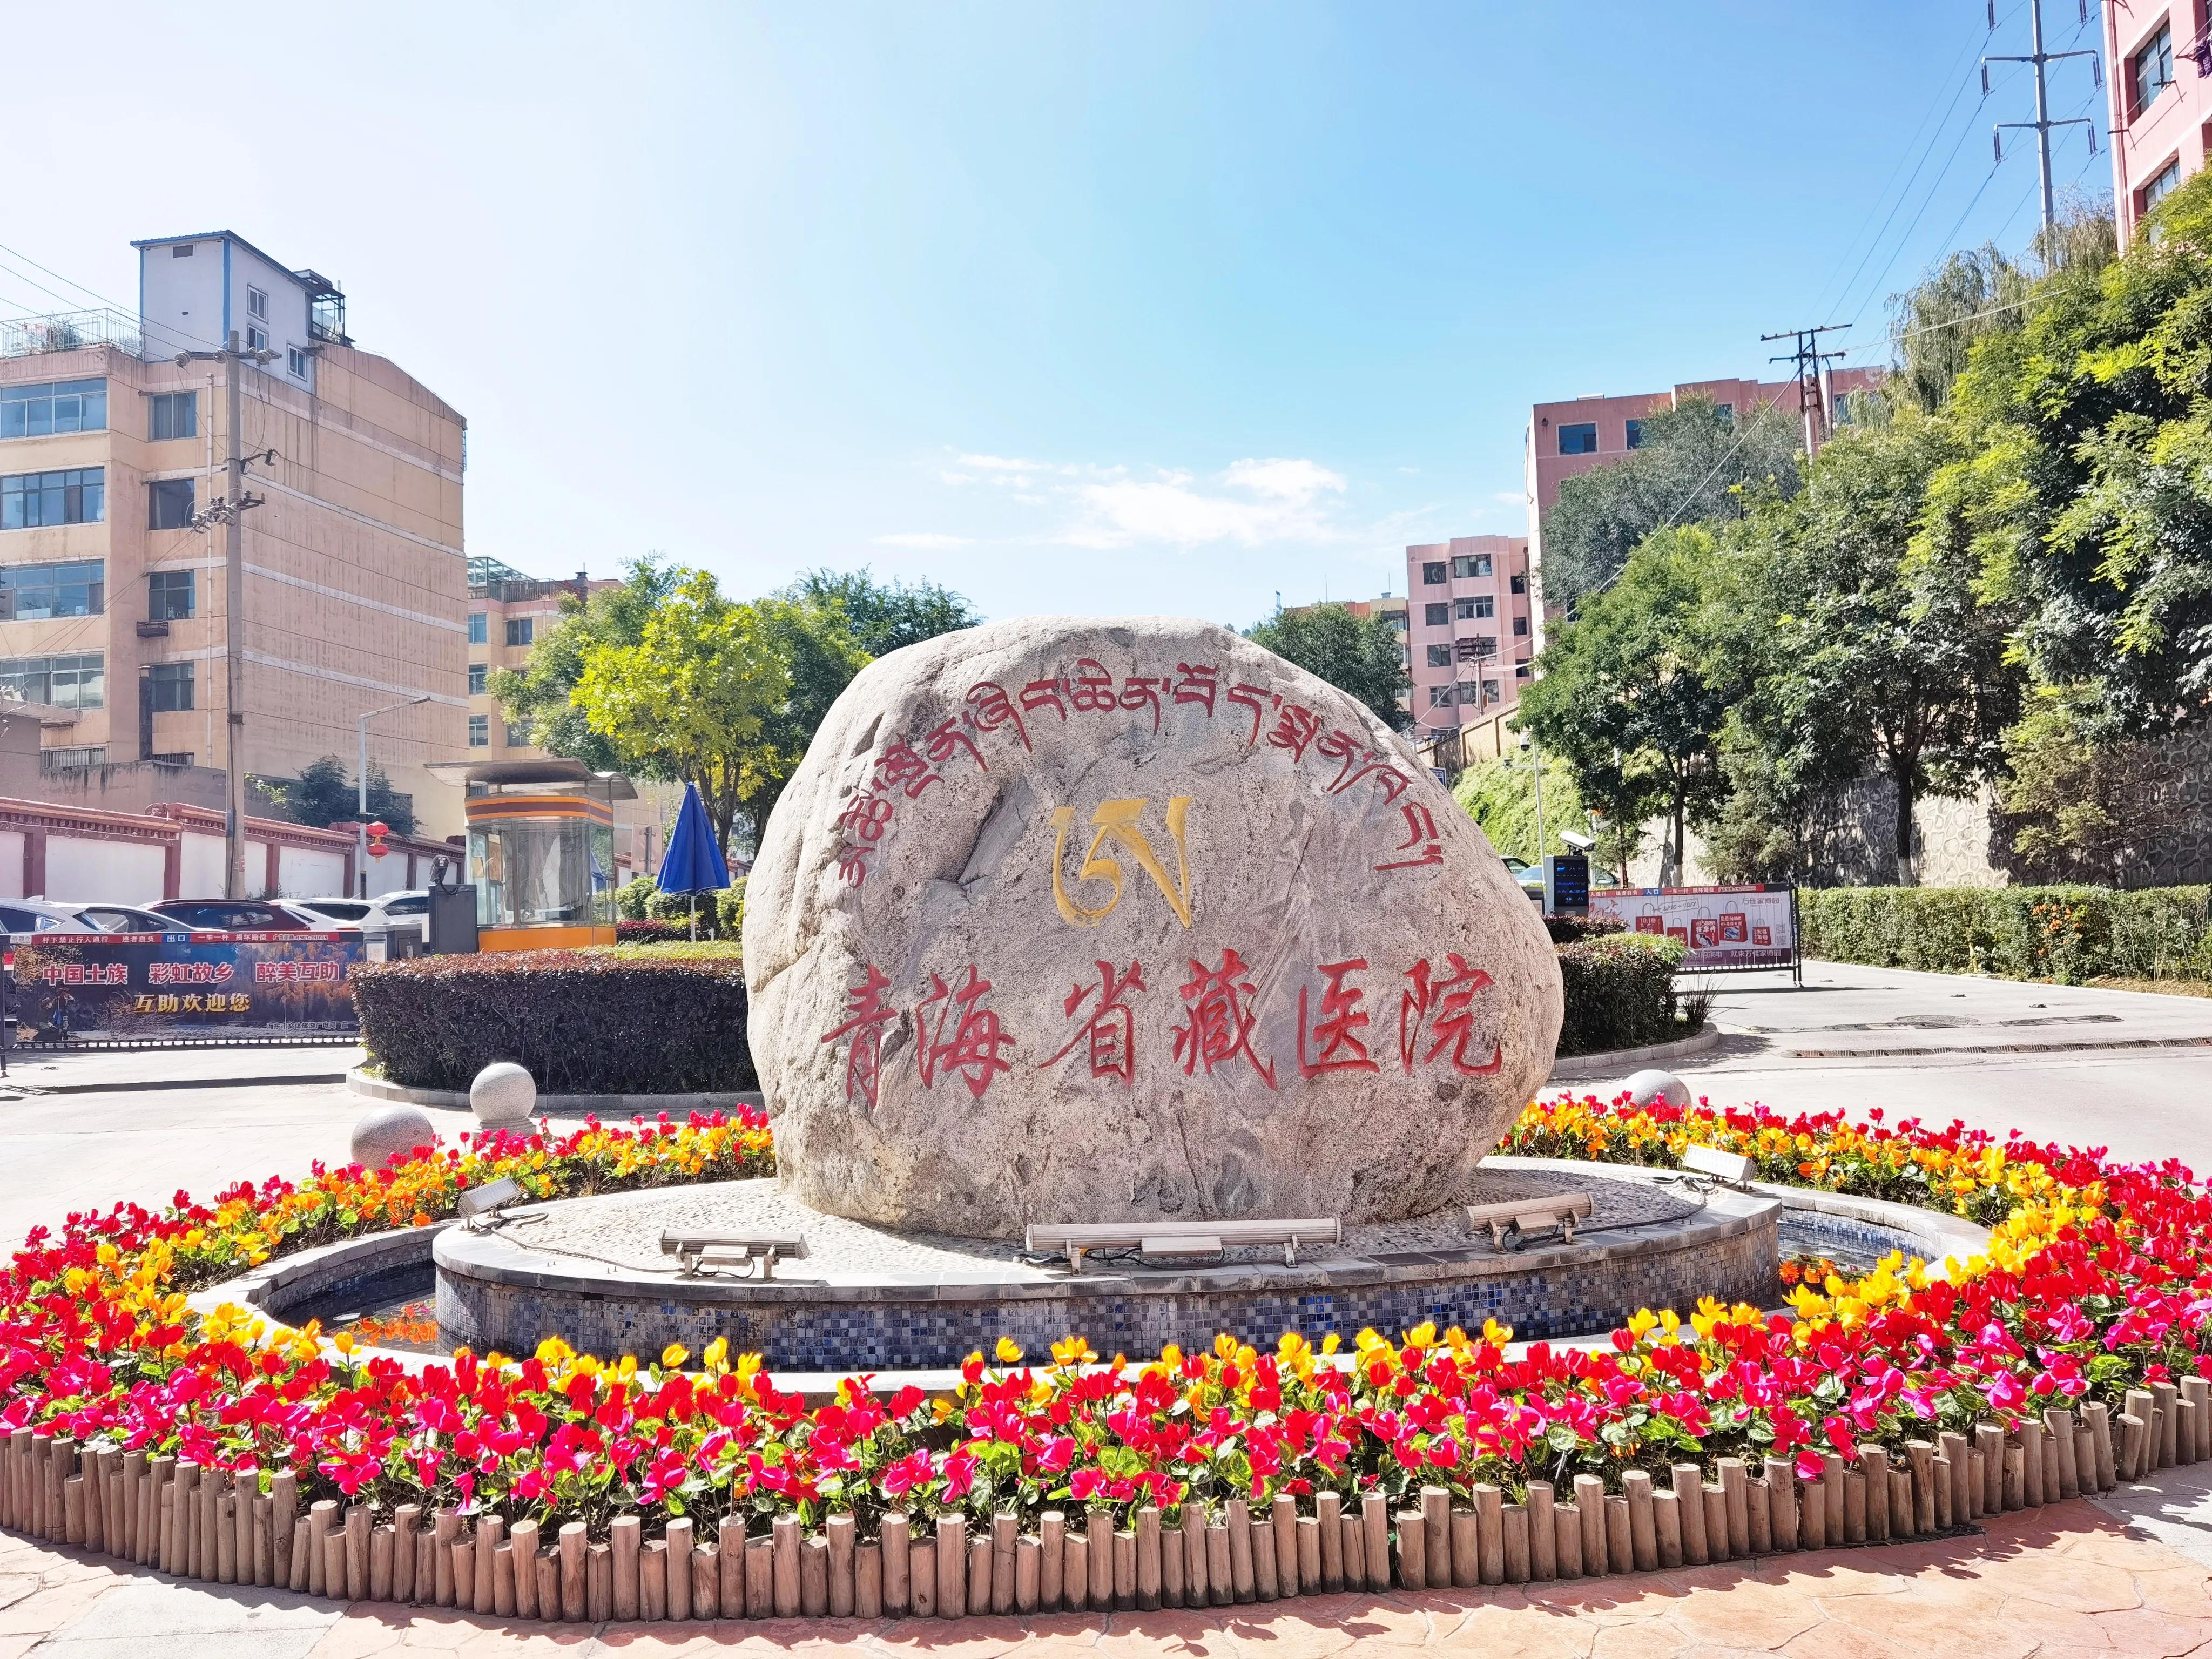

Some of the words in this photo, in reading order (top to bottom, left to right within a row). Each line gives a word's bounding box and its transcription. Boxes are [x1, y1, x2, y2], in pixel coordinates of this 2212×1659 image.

[42, 935, 109, 943] 杆下禁止行人通行
[42, 963, 128, 986] 中国土族
[148, 962, 234, 984] 彩虹故乡
[255, 961, 340, 983] 醉美互助
[133, 992, 251, 1013] 互助欢迎您
[821, 948, 1505, 1110] 青海省藏医院
